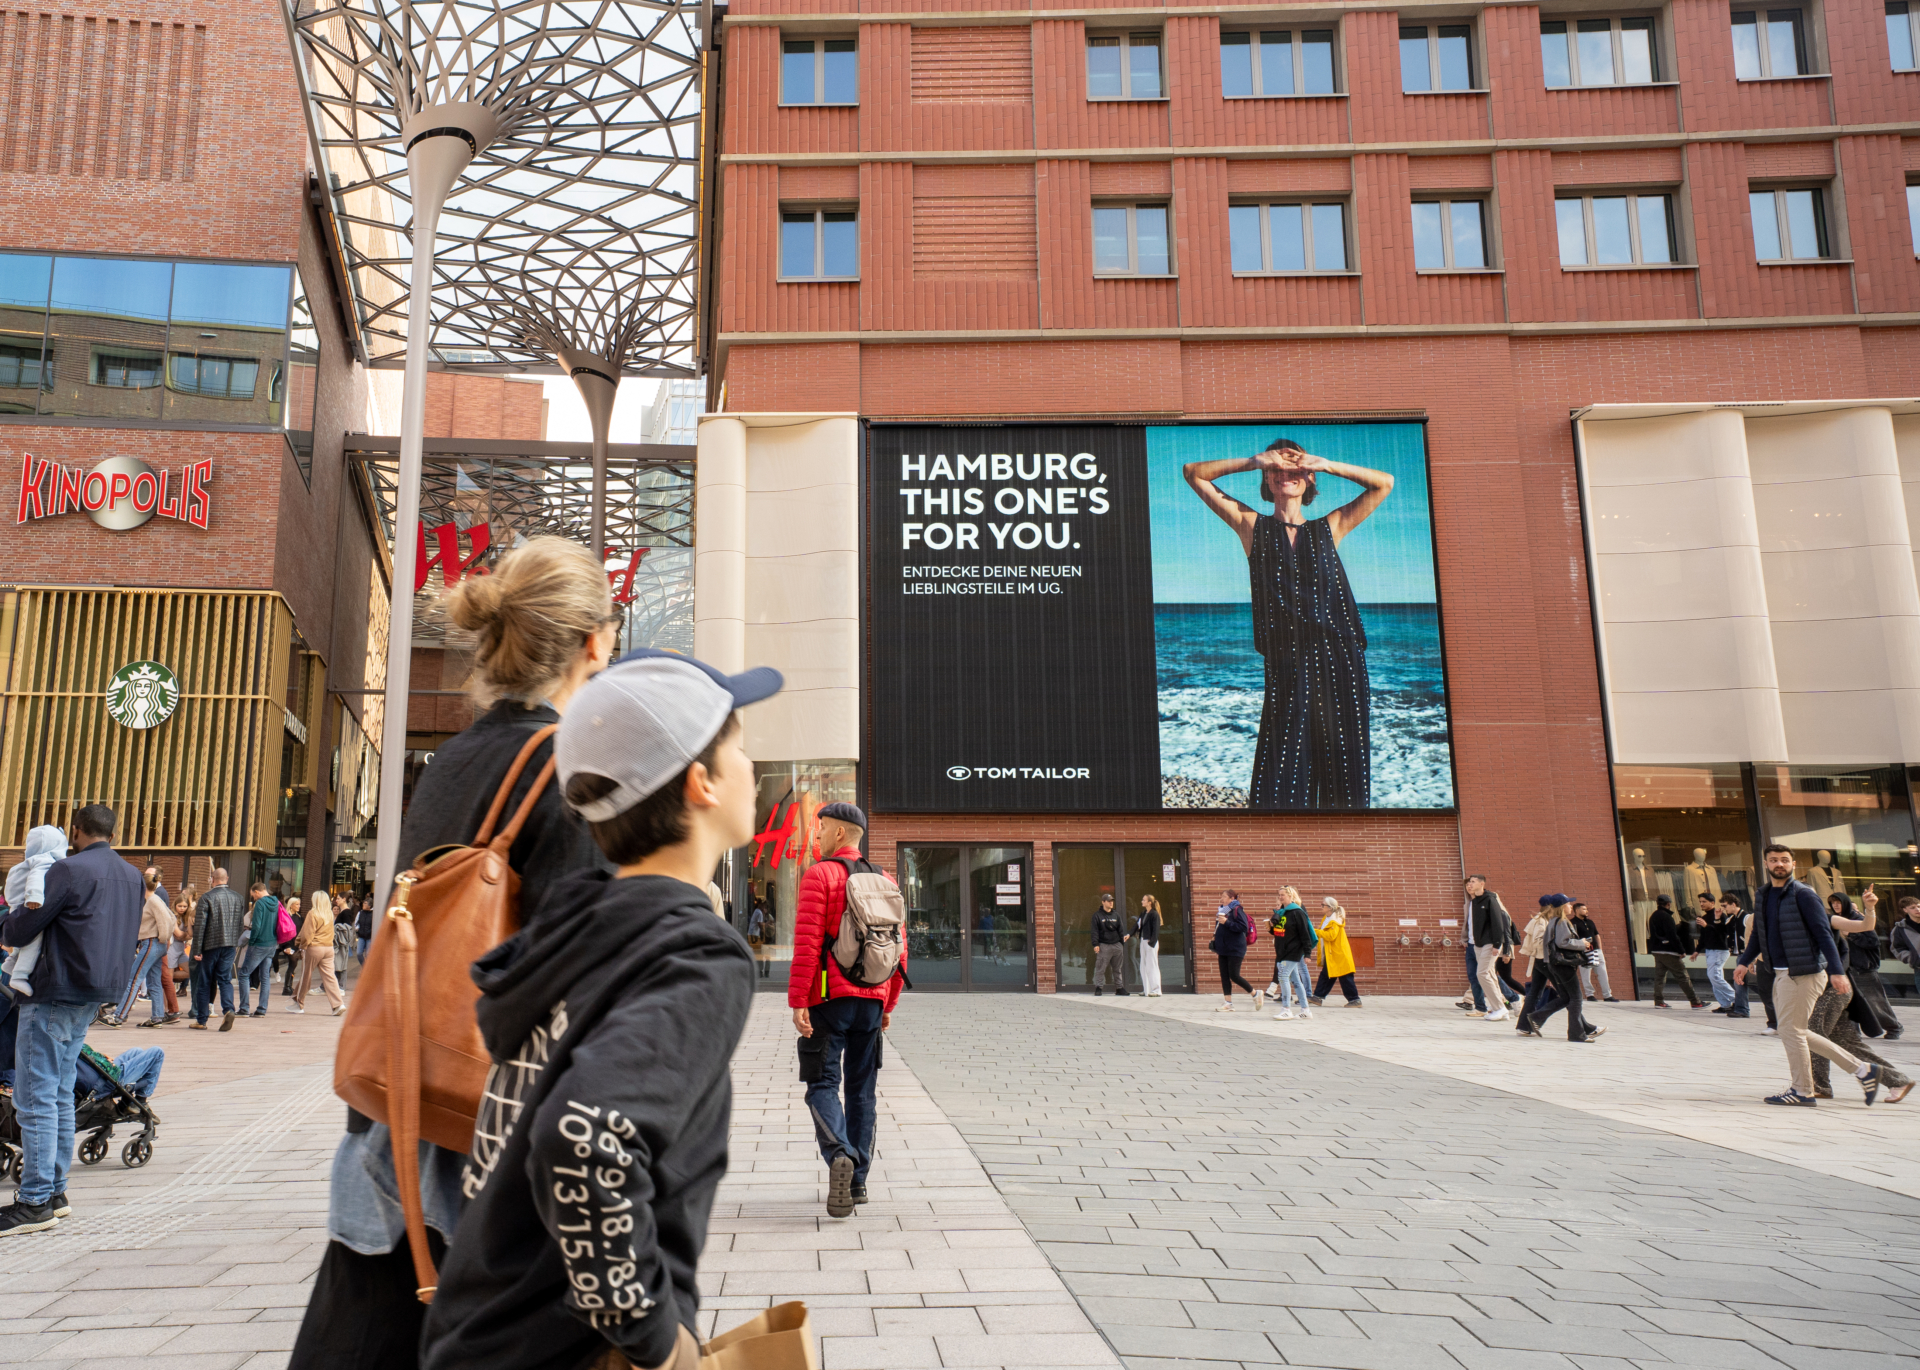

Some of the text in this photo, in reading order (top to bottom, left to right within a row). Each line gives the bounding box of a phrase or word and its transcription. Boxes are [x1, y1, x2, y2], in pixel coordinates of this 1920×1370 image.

[902, 453, 1107, 484] HAMBURG,
[17, 452, 213, 530] KINOPOLIS
[900, 487, 1110, 515] THIS ONE'S
[902, 522, 1081, 550] FOR YOU.
[903, 565, 1082, 578] ENTDECKE DEINE NEUEN
[903, 583, 1064, 595] LIEBLINGSTEILE IM UG.
[974, 767, 1090, 779] TOM TAILOR
